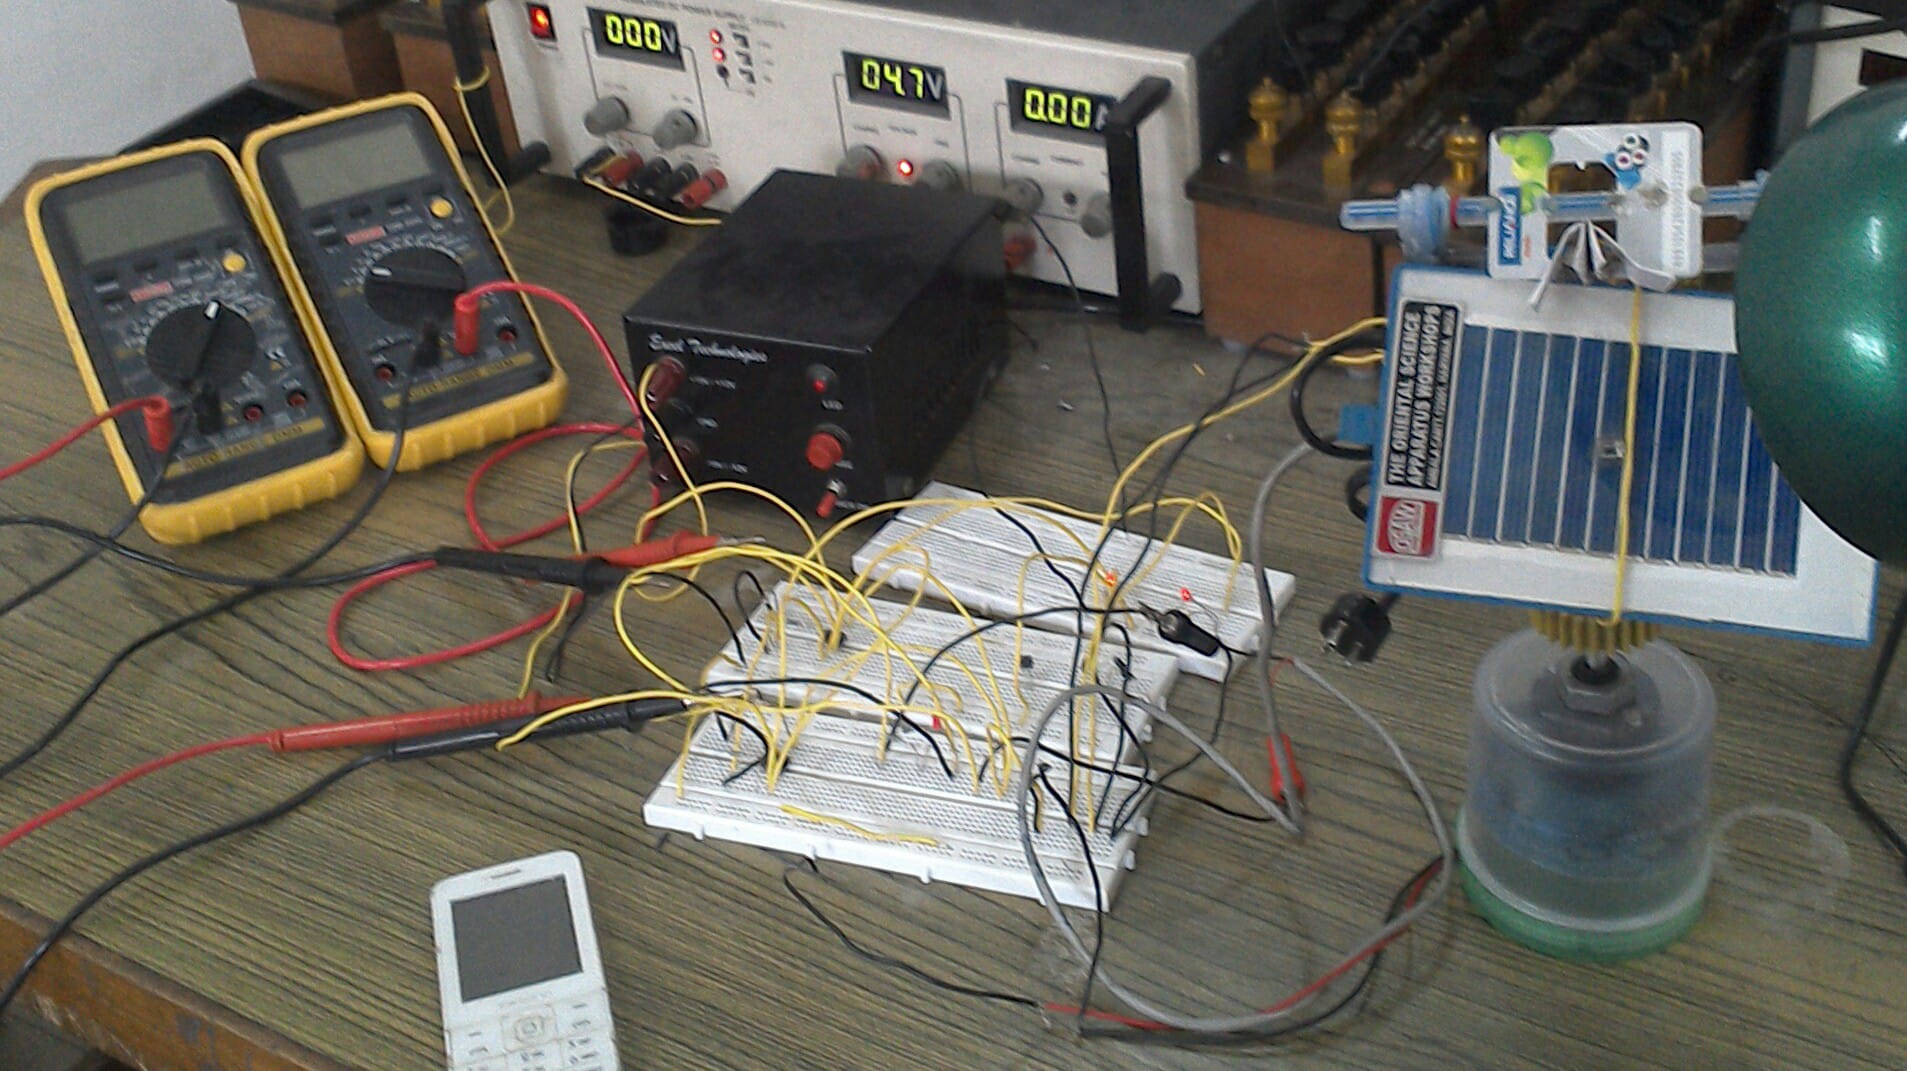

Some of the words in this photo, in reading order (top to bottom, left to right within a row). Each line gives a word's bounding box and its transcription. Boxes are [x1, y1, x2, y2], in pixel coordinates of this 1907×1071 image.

[1399, 311, 1422, 377] SCIENCE
[1415, 305, 1442, 399] WORKSHOPS
[1391, 379, 1416, 452] ORIENTAL
[1406, 400, 1432, 487] APPARATUS
[1387, 453, 1407, 483] THE
